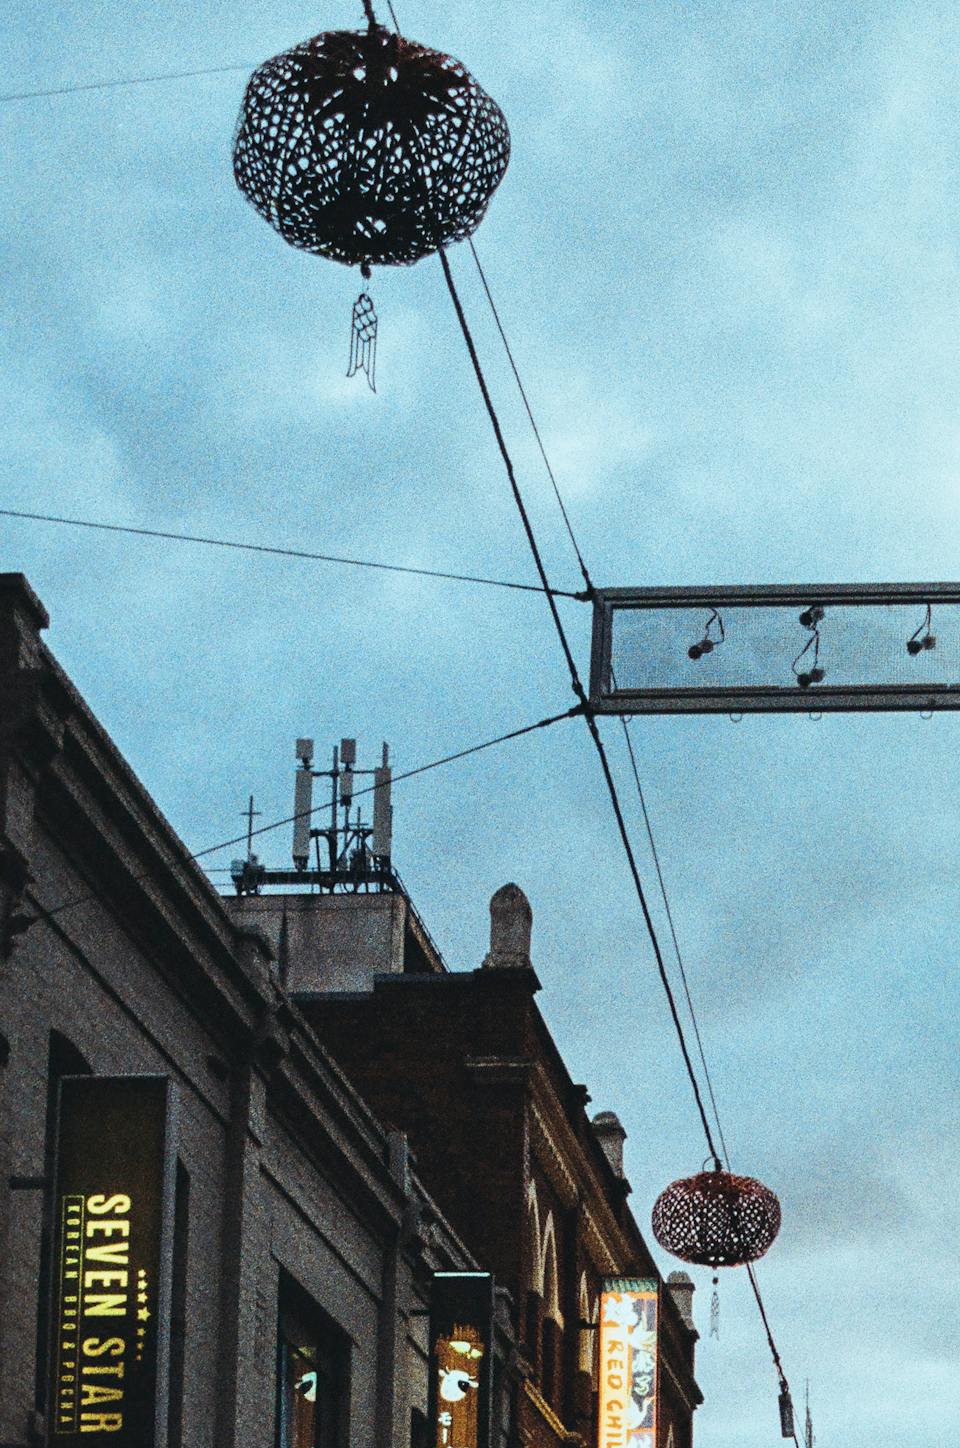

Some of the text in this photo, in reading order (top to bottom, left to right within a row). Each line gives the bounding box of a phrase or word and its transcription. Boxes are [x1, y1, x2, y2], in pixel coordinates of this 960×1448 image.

[63, 1204, 81, 1280] KOREAN
[80, 1193, 132, 1433] SEVEN STAR
[606, 1339, 625, 1390] RED
